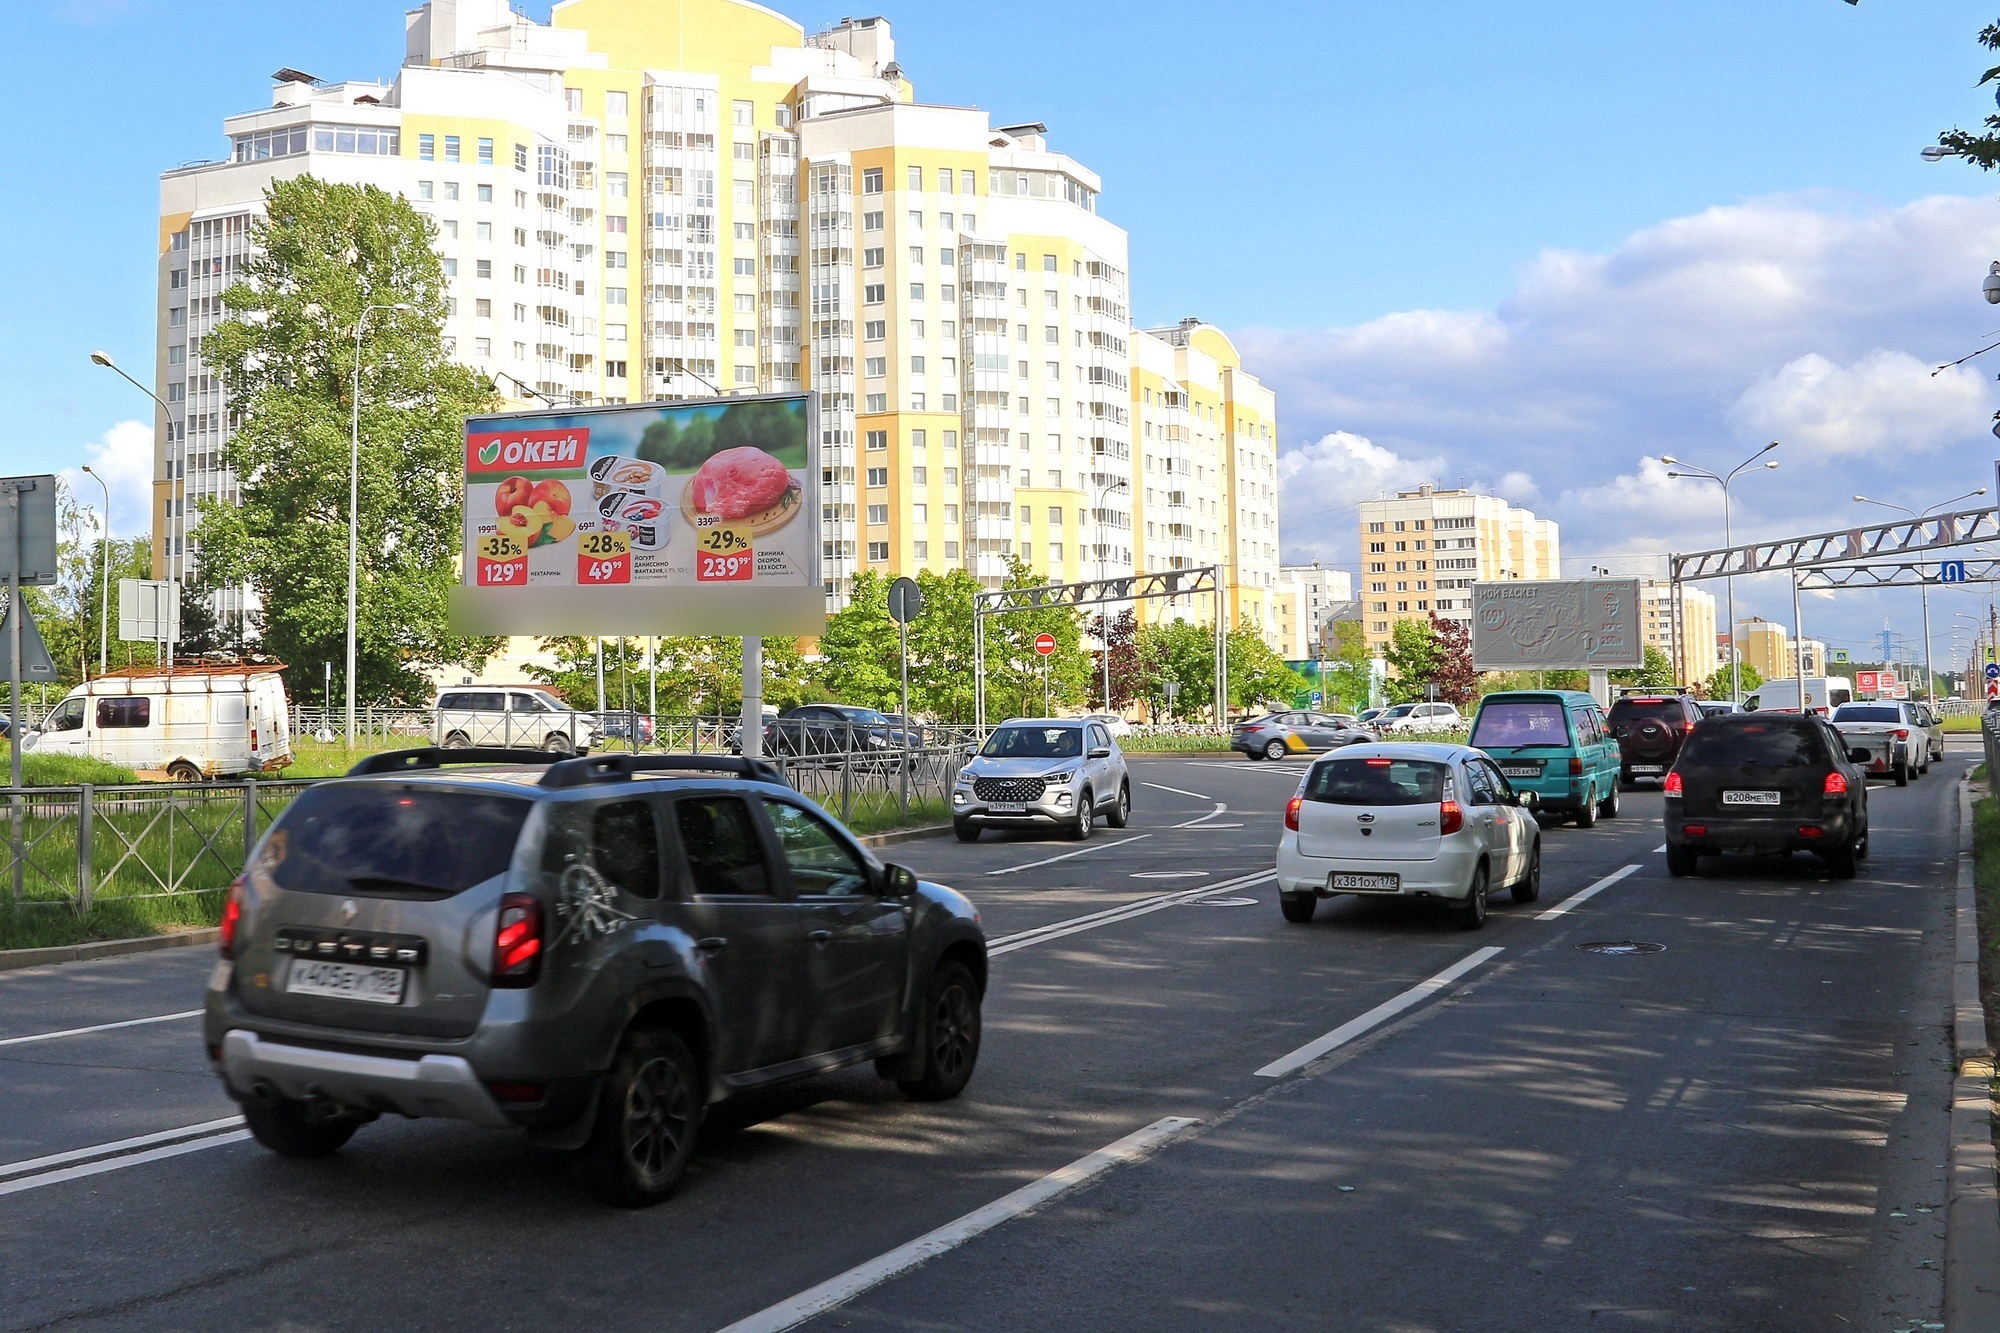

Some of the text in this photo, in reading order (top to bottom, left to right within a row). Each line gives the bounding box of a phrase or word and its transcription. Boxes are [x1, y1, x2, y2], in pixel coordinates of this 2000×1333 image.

[483, 538, 522, 555] -35%
[583, 535, 626, 553] -28%
[704, 530, 747, 549] -29%
